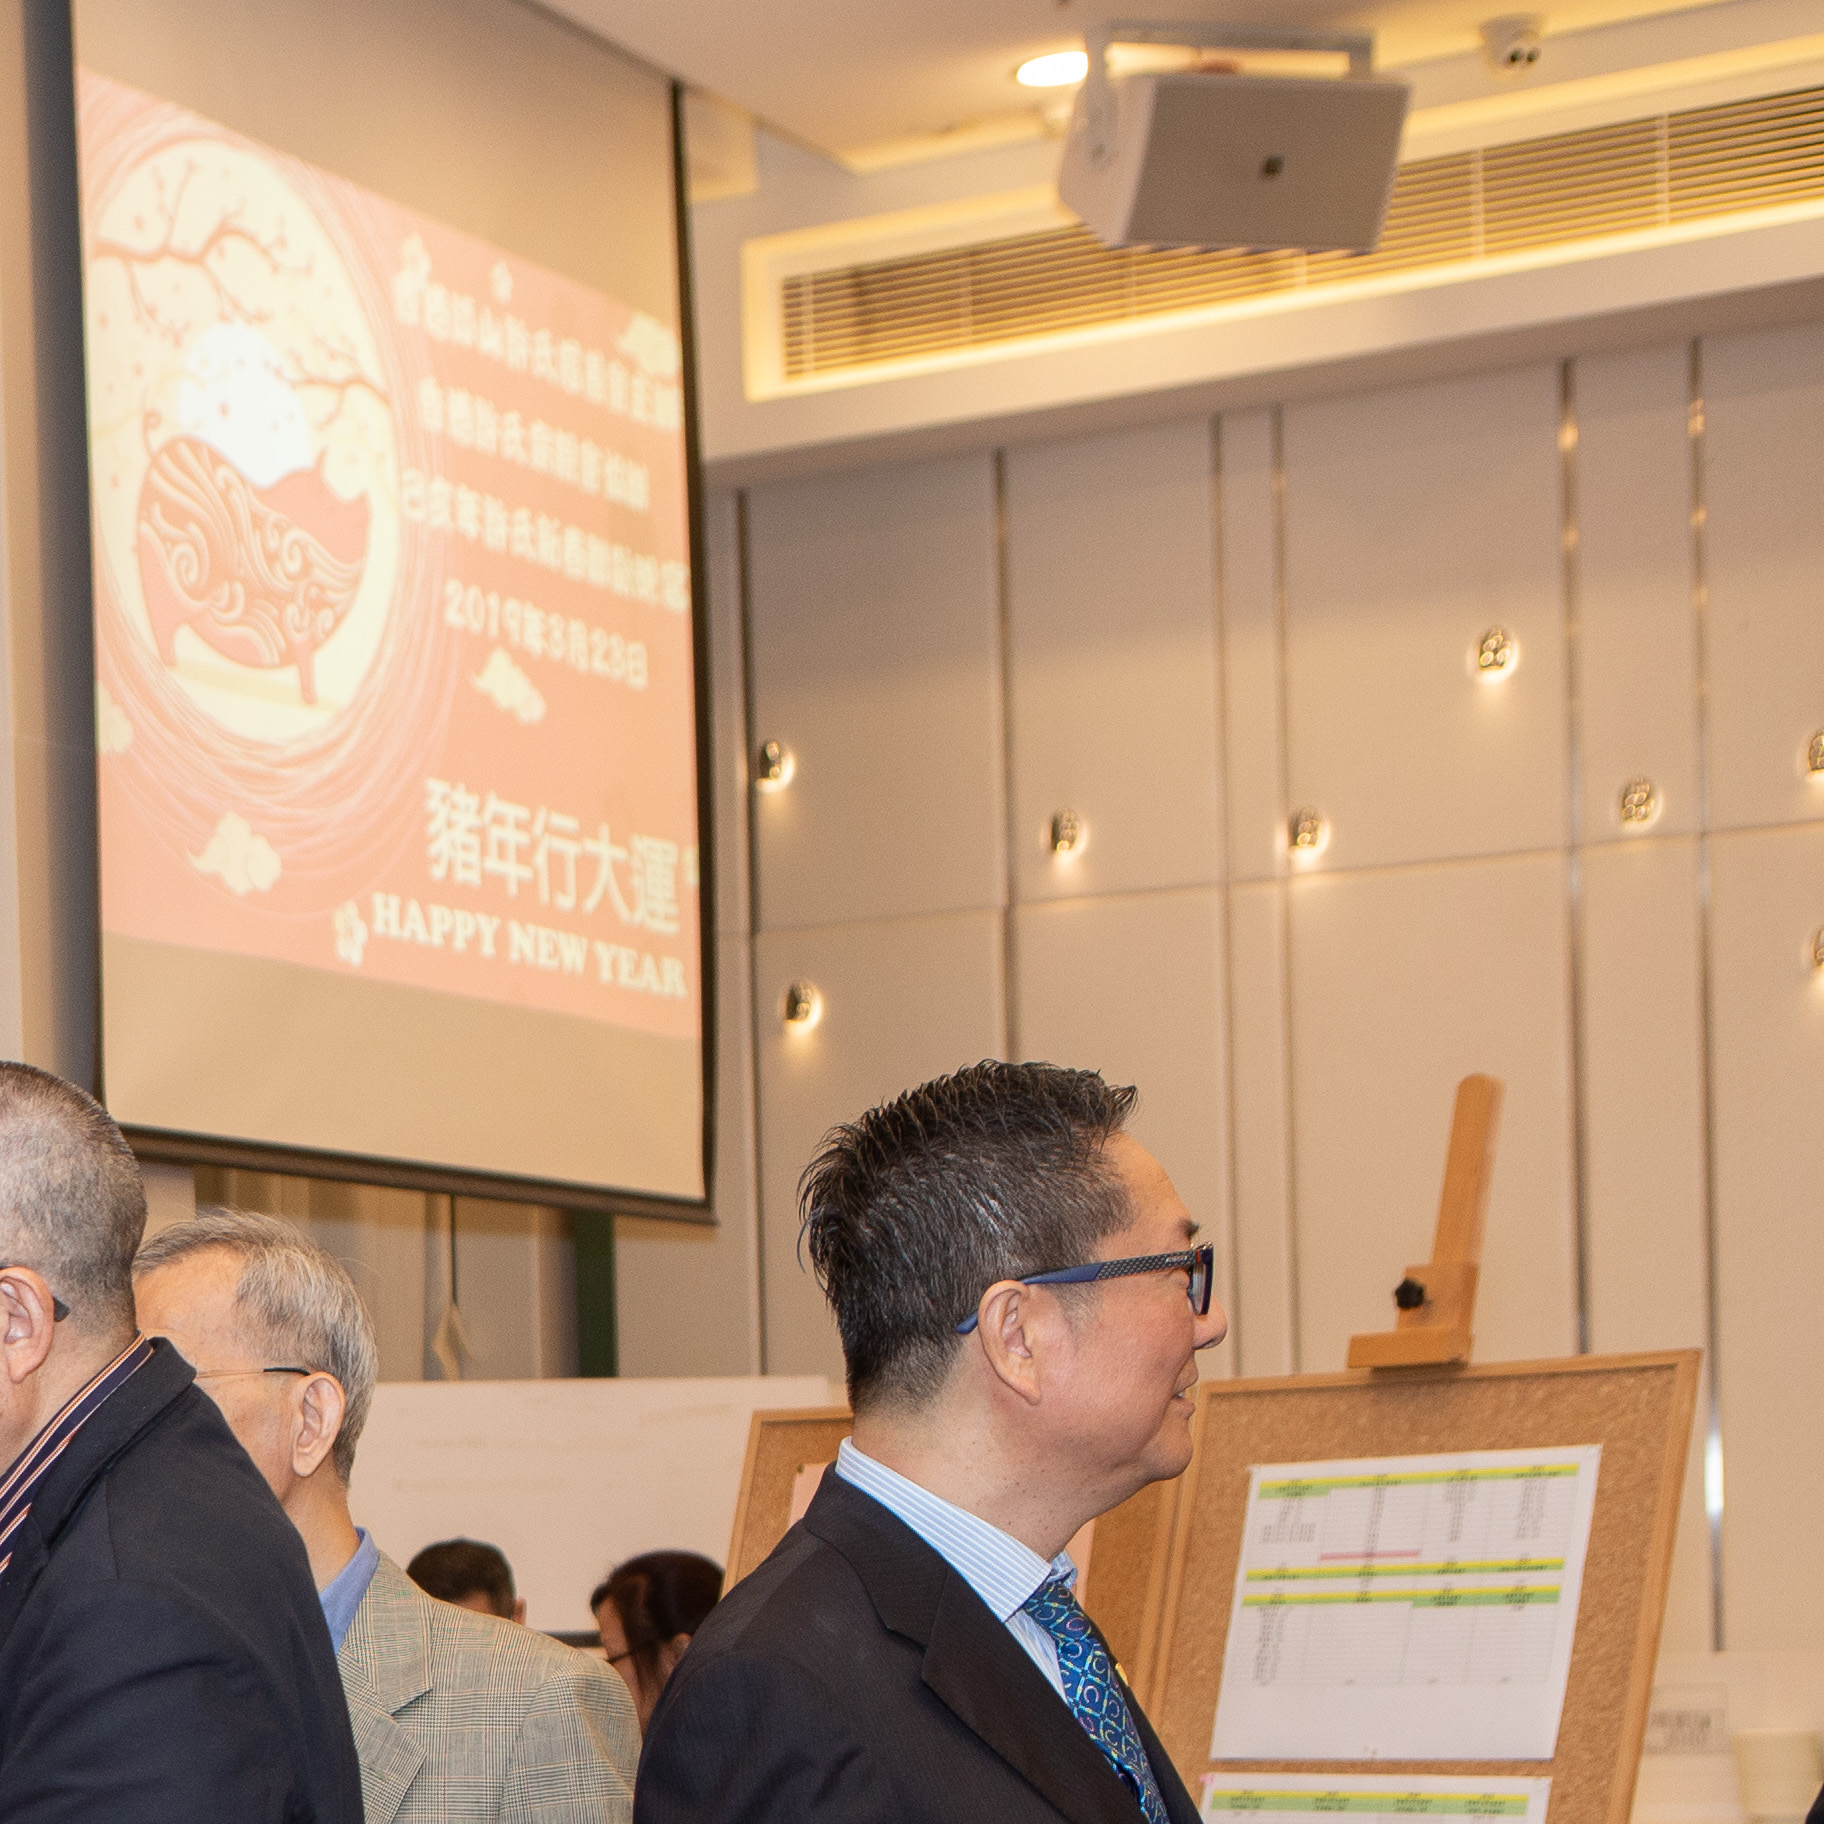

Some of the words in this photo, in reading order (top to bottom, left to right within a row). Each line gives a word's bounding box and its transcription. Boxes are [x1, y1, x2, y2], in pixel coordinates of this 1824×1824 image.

[443, 576, 650, 692] 2019年3月23日
[425, 775, 682, 936] 豬年行大運
[371, 889, 501, 958] HAPPY
[507, 917, 589, 975] NEW
[595, 938, 688, 999] YEAR
